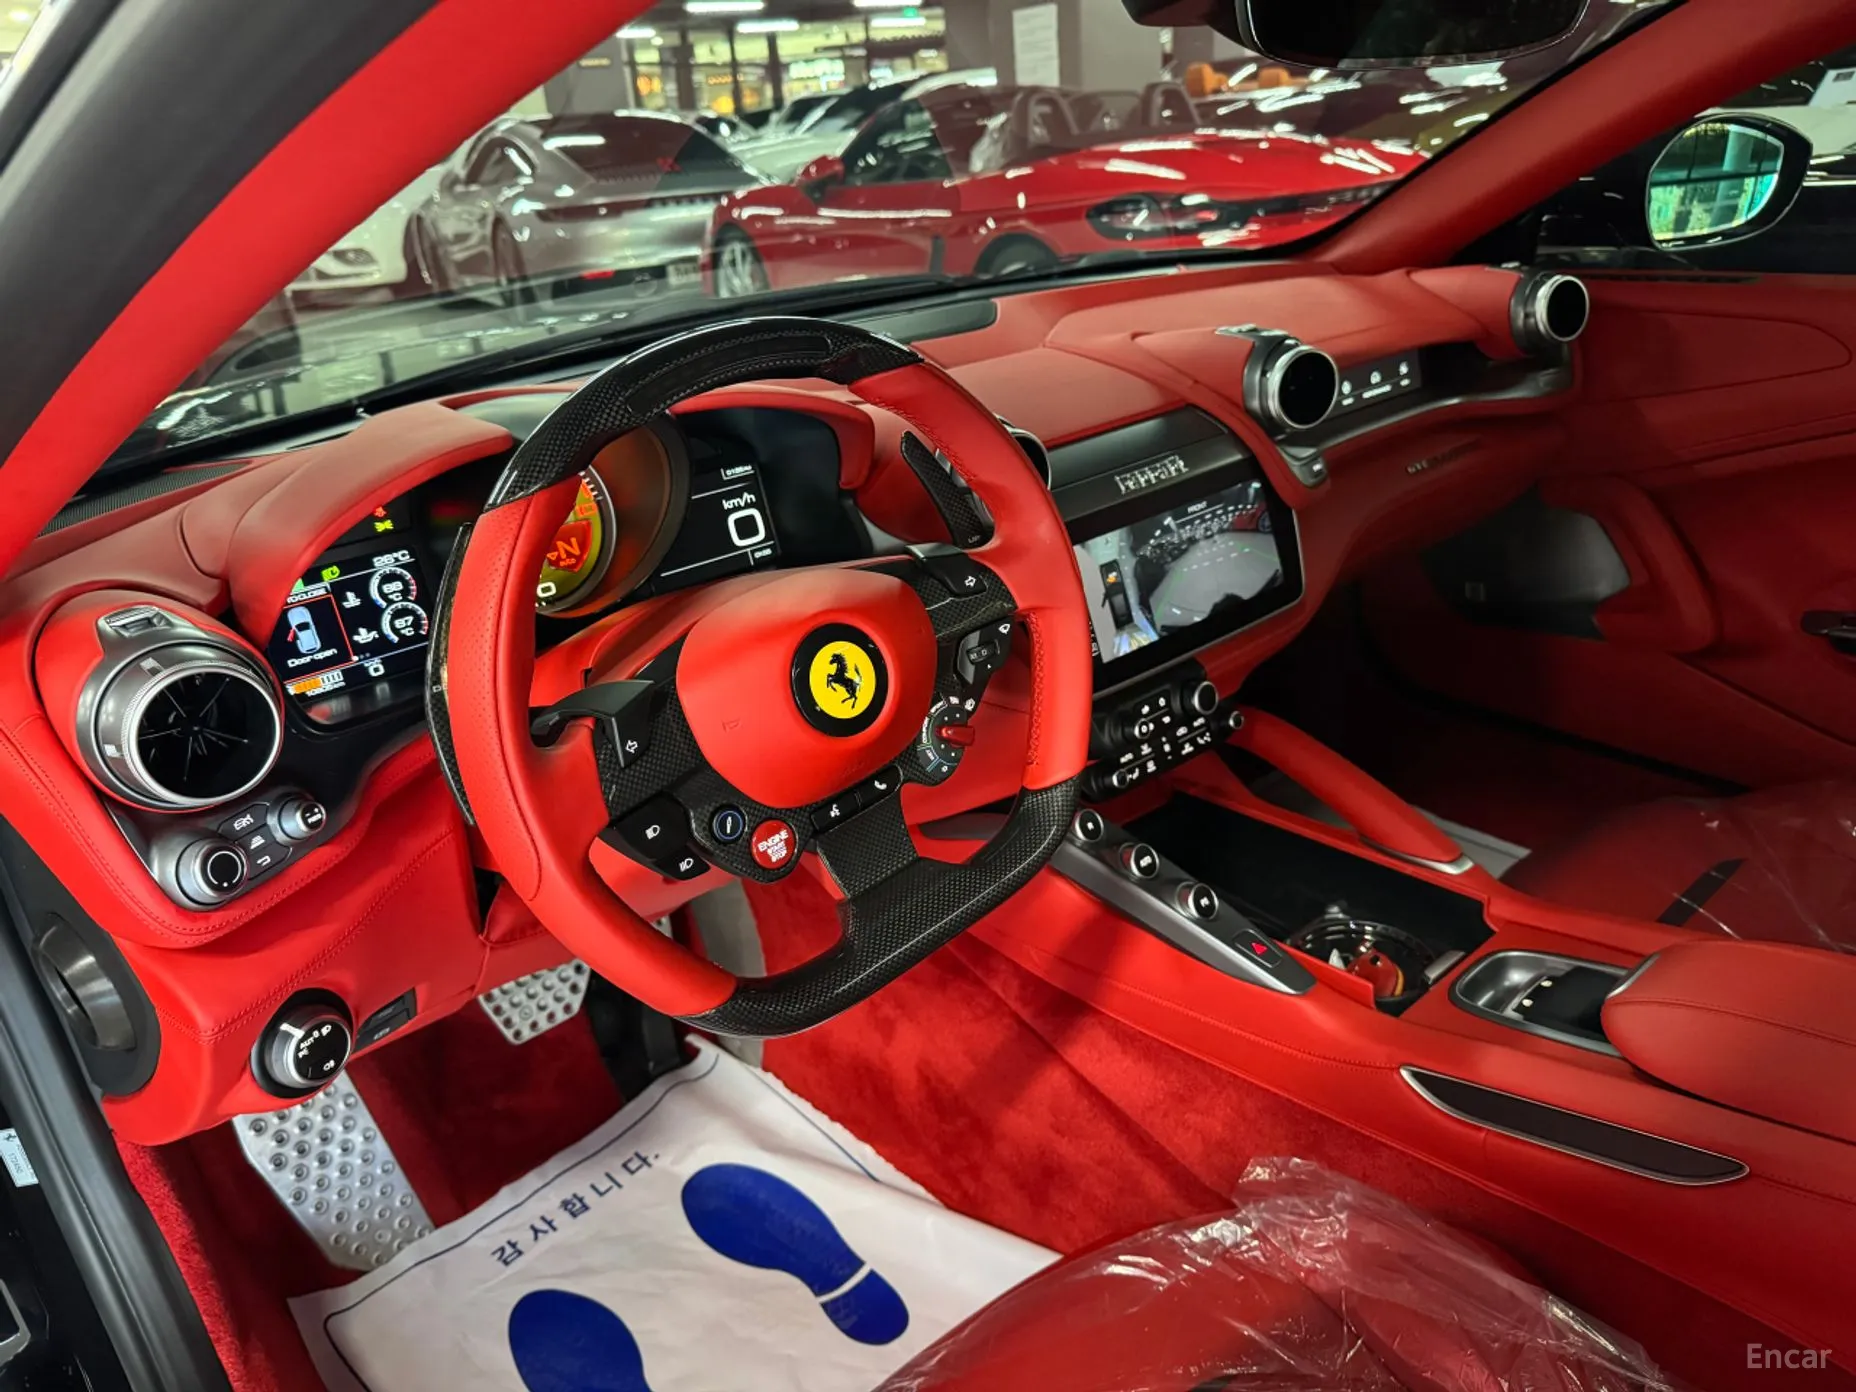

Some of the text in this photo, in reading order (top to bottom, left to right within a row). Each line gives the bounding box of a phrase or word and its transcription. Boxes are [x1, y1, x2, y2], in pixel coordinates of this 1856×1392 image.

[1114, 454, 1189, 495] Ferrari
[722, 491, 757, 511] km/h
[728, 508, 766, 547] 0
[556, 537, 580, 559] N
[287, 648, 338, 668] Door open
[757, 829, 789, 852] ENGINE
[300, 1029, 320, 1049] AUTO
